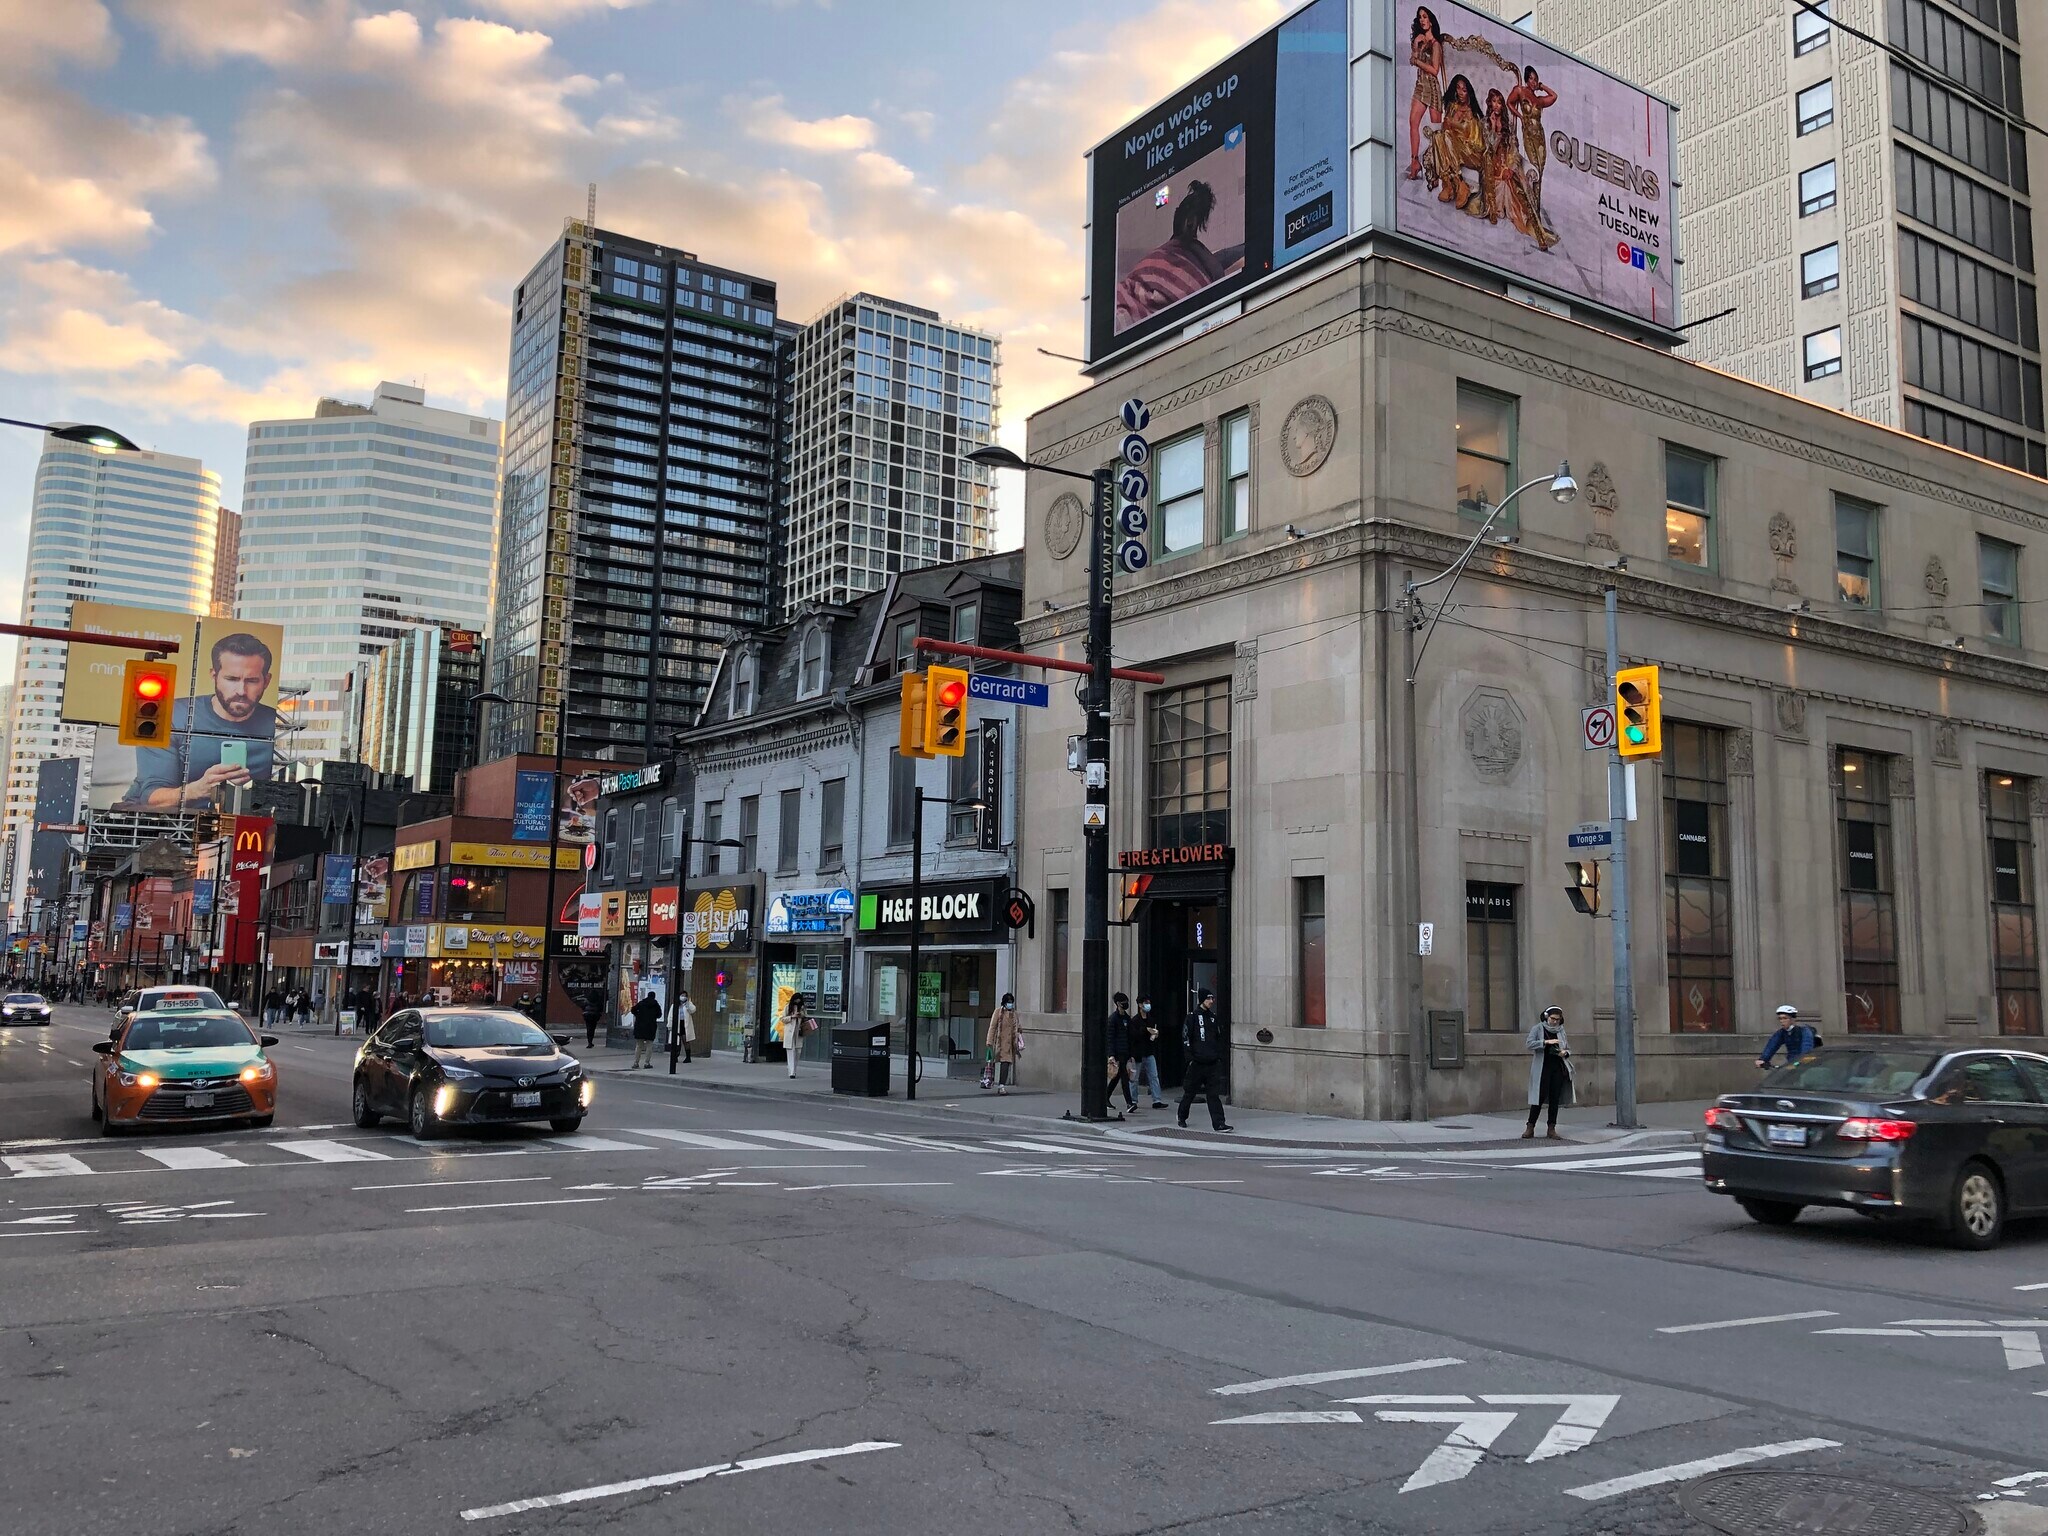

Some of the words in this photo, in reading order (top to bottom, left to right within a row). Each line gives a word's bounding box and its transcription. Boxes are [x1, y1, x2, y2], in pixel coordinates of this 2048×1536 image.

[1124, 118, 1165, 159] Nova
[1168, 90, 1212, 127] woke
[1216, 73, 1239, 99] up
[1145, 139, 1174, 171] like
[1177, 116, 1213, 149] this.
[1288, 173, 1299, 184] For
[1299, 157, 1330, 179] grooming
[1550, 130, 1661, 202] QUEENS
[1292, 190, 1306, 202] and
[1598, 192, 1625, 216] ALL
[1628, 206, 1660, 229] NEW
[1287, 203, 1330, 240] petvalu
[1598, 211, 1660, 249] TUESDAYS
[1616, 241, 1660, 274] CTV
[1121, 399, 1149, 573] Yonge
[1102, 481, 1113, 605] DOWNTOWN
[451, 632, 472, 642] CIBC
[969, 675, 1026, 700] Gerrard
[1028, 684, 1037, 695] St
[619, 772, 639, 791] Pasha
[638, 763, 661, 787] LOUNGE
[987, 750, 995, 812] CHRONIC
[517, 801, 545, 809] INDULGE
[515, 812, 552, 820] TORONTO'S
[513, 818, 545, 826] CULTURAL
[525, 824, 547, 832] HEART
[1575, 834, 1597, 845] Yonge
[1598, 834, 1604, 842] St
[1678, 833, 1707, 843] CANNABIS
[1118, 843, 1224, 868] FIRE&FLOWER
[1849, 851, 1874, 860] CANNABIS
[3, 834, 16, 893] NORDSTROM
[1995, 866, 2017, 875] CANNABIS
[920, 893, 980, 921] BLOCK
[1465, 896, 1511, 907] ANNABIS
[770, 917, 787, 925] HOT
[767, 924, 789, 932] STAR
[504, 961, 538, 975] NAILS
[806, 971, 815, 981] For
[828, 972, 838, 982] For
[919, 973, 933, 987] tax
[802, 981, 816, 991] Lease
[826, 982, 840, 992] Lease
[918, 987, 940, 997] course
[162, 999, 199, 1008] 751-5555
[919, 1003, 937, 1013] BLOCK
